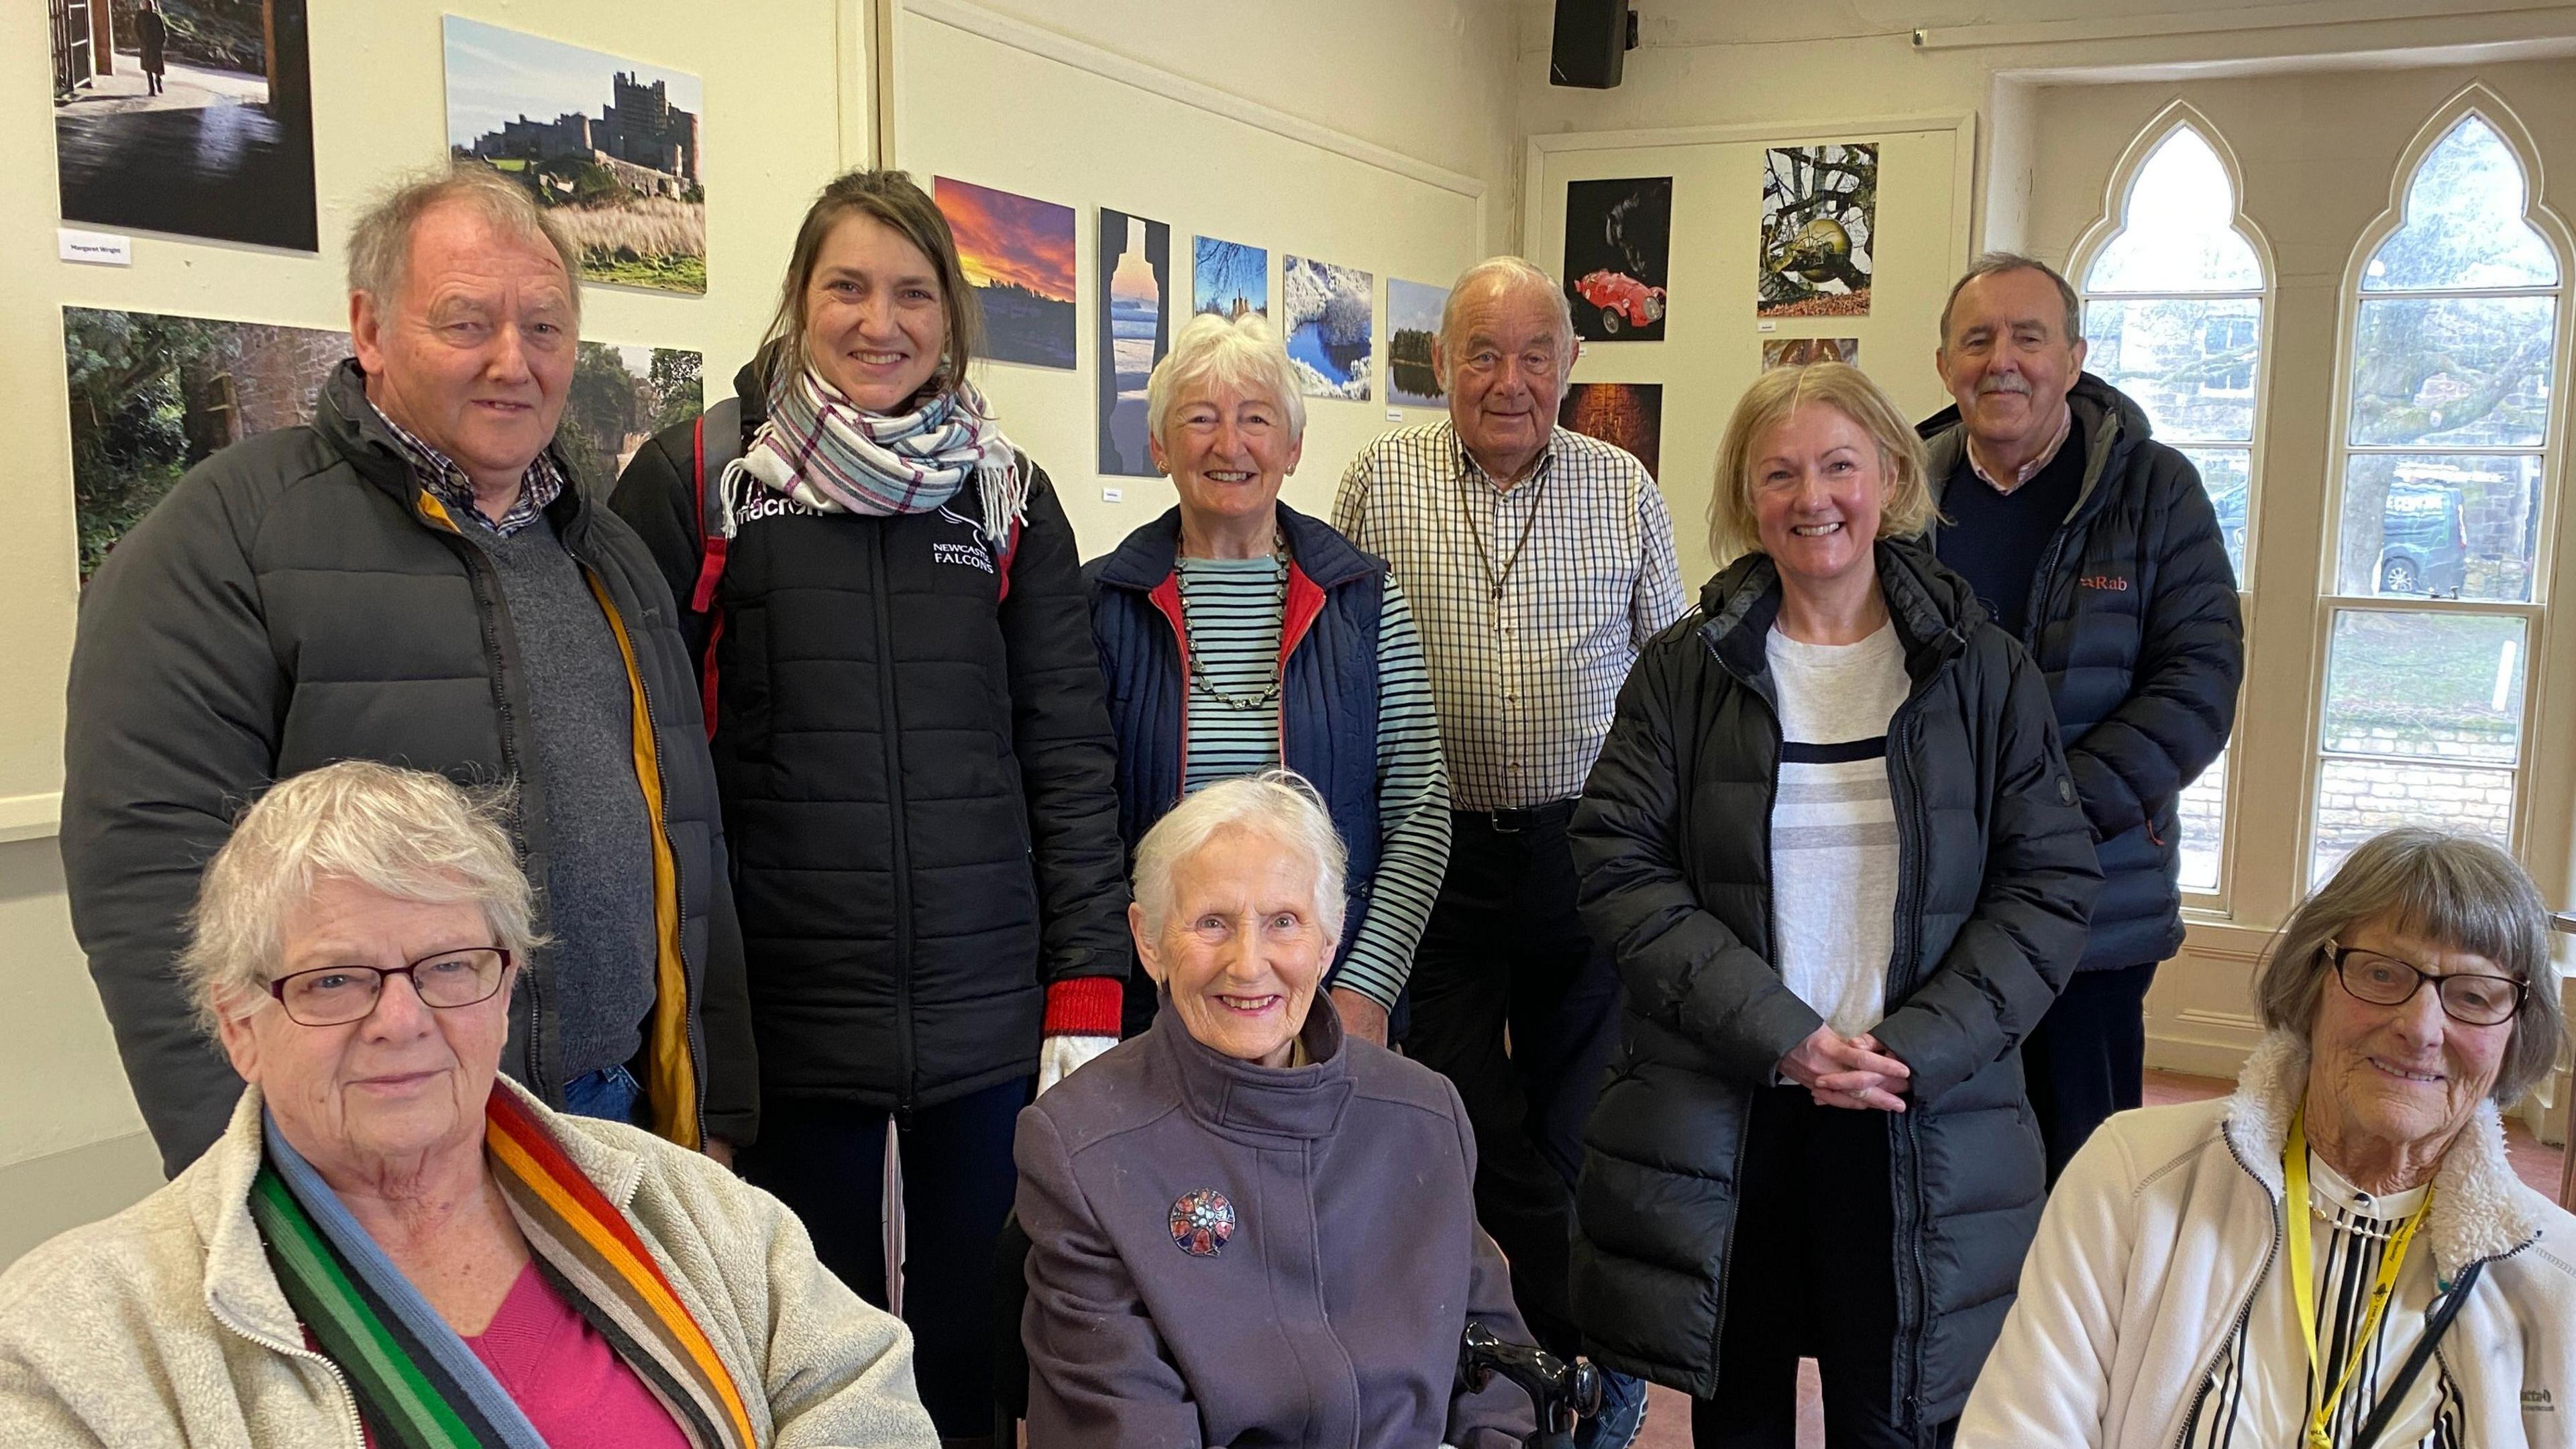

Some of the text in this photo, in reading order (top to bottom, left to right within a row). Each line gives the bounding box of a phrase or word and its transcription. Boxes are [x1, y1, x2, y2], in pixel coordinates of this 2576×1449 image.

[933, 543, 991, 564] NEWCASTLE
[934, 553, 994, 574] FALCONS
[2096, 576, 2127, 591] Rab
